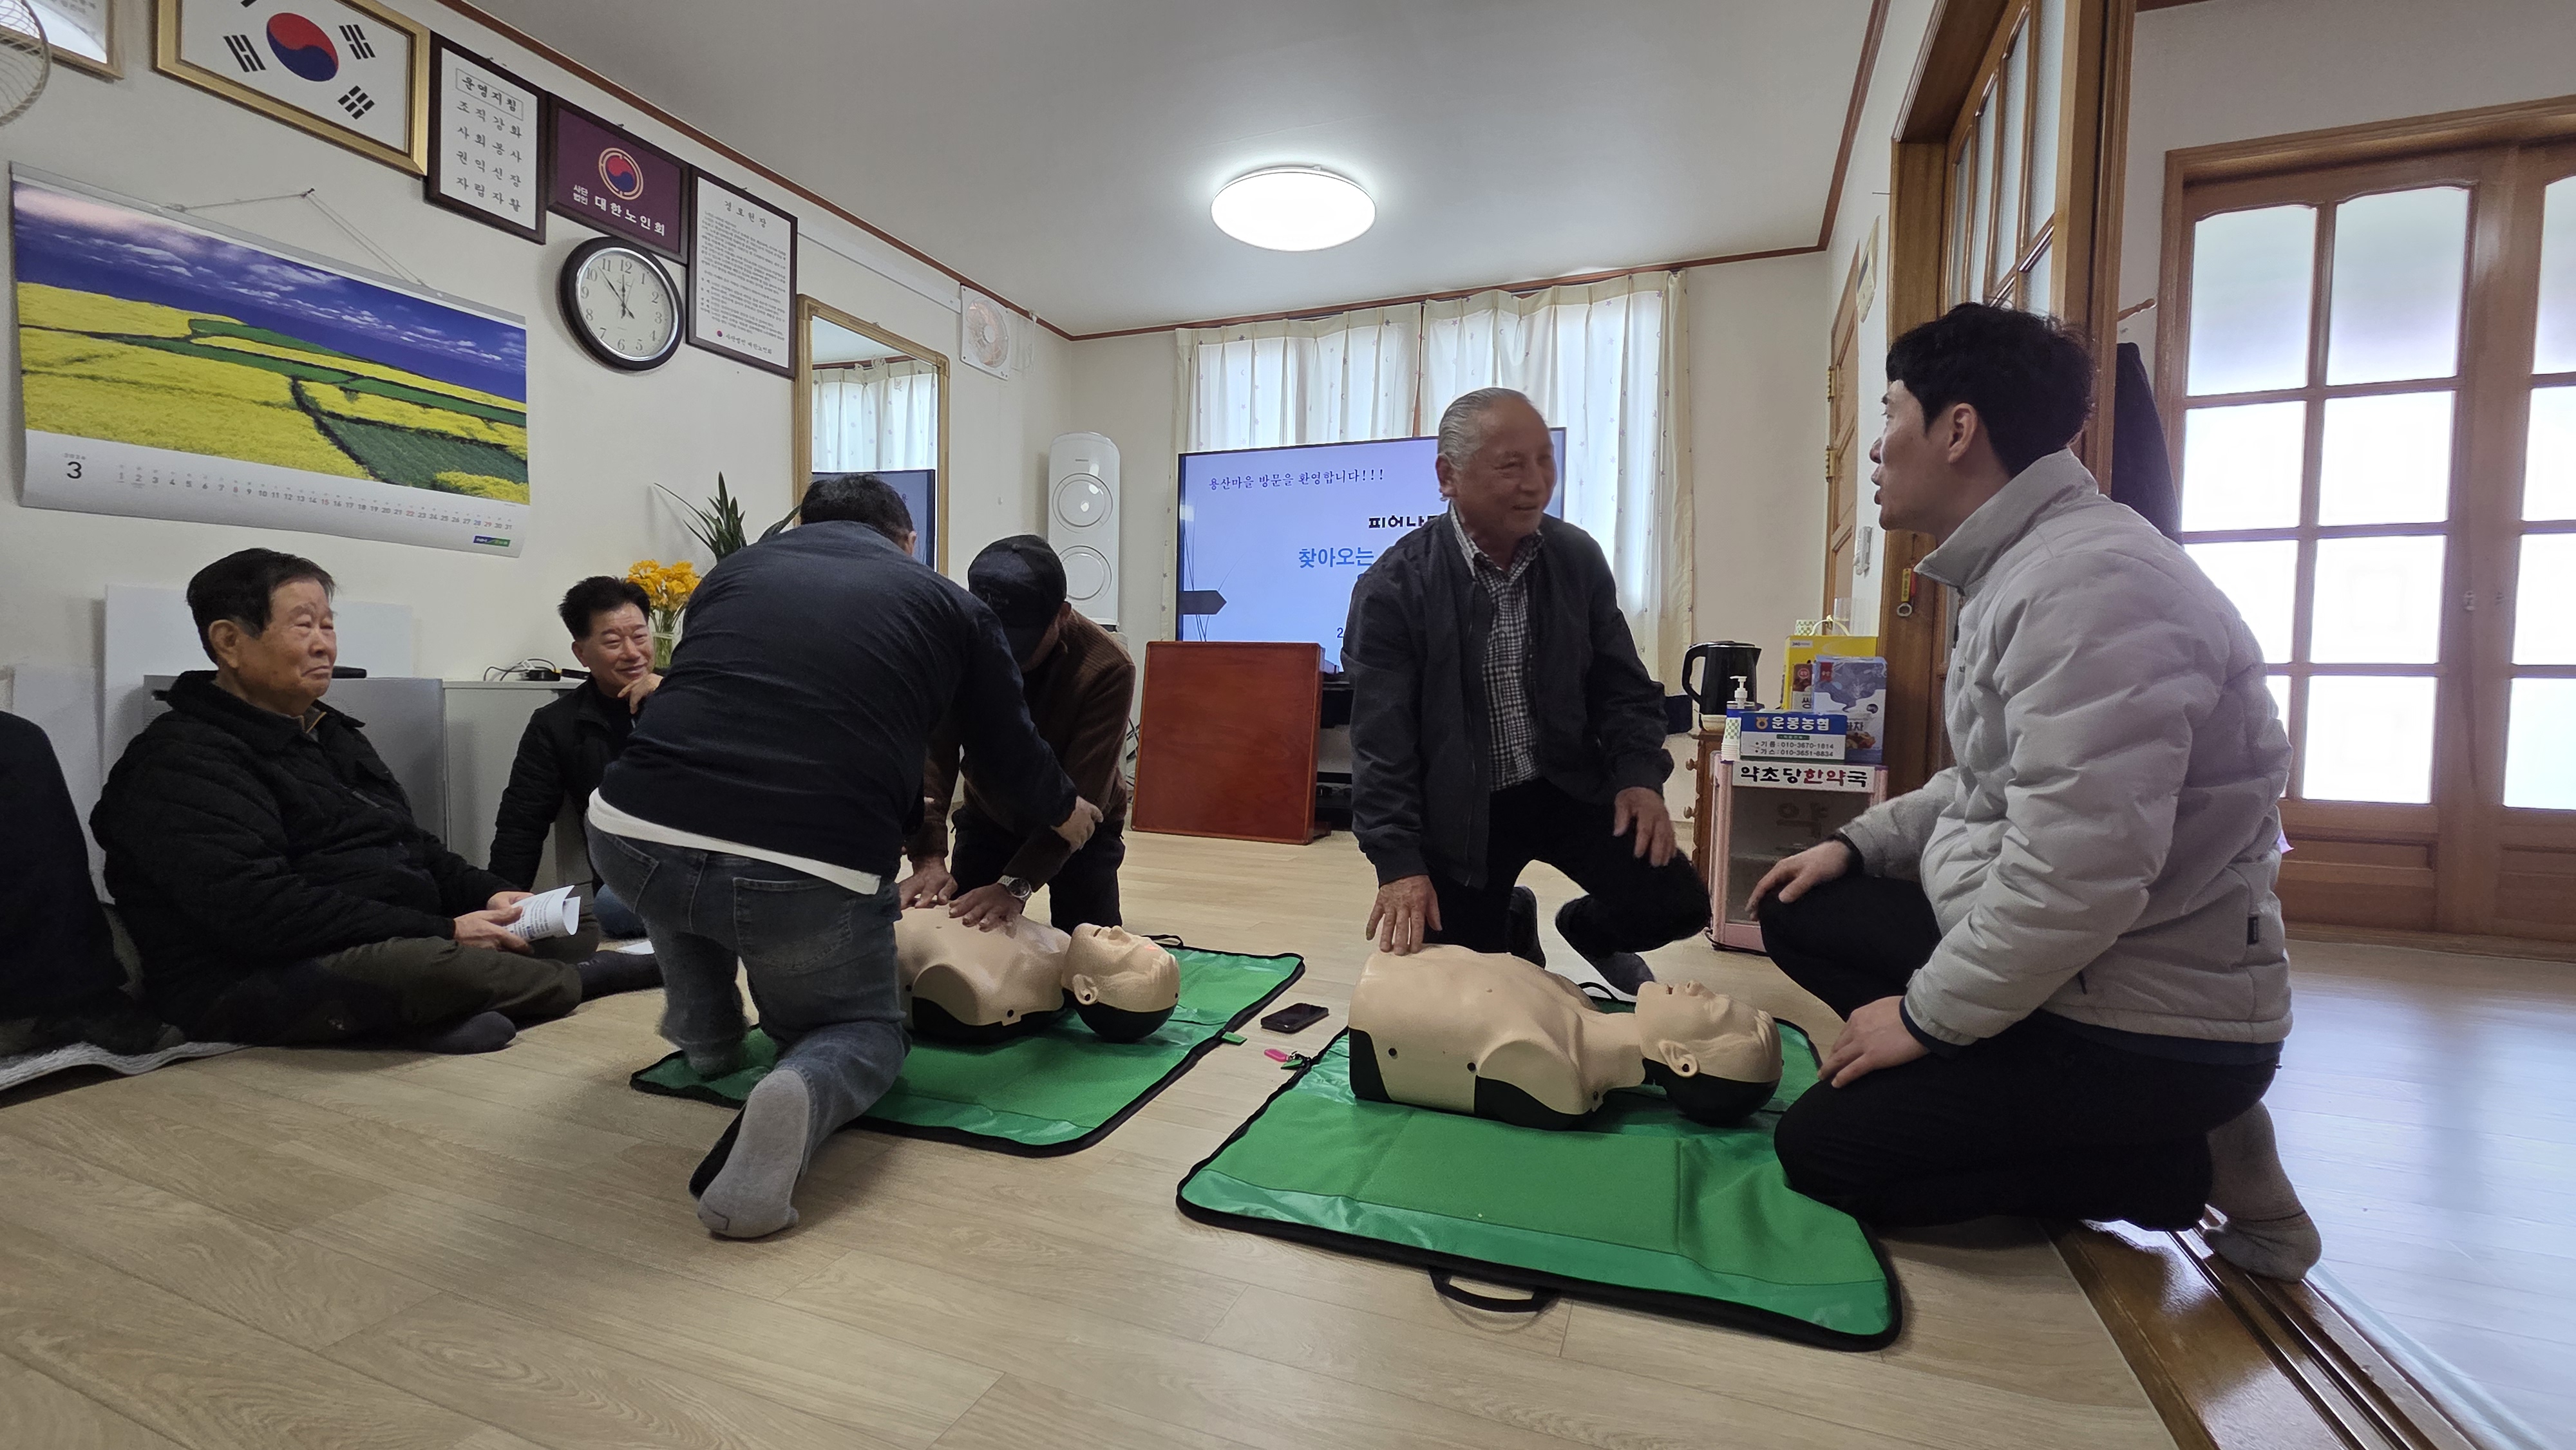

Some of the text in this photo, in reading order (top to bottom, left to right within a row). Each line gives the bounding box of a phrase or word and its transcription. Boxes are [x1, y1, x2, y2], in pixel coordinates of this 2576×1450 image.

[462, 77, 517, 112] 운영지침
[457, 100, 522, 138] 조직강화
[457, 126, 522, 163] 사회봉사
[456, 151, 522, 187] 권익신장
[456, 177, 521, 212] 자립자활
[573, 184, 589, 196] 사단
[573, 193, 588, 205] 법인
[594, 195, 665, 236] 대한노인회
[601, 258, 611, 272] 11
[620, 259, 632, 274] 12
[586, 267, 598, 281] 10
[641, 273, 645, 285] 1
[580, 286, 589, 299] 9
[652, 291, 659, 304] 2
[585, 308, 594, 321] 8
[654, 312, 662, 324] 3
[600, 327, 607, 339] 7
[649, 330, 656, 341] 4
[617, 338, 625, 351] 6
[636, 339, 643, 351] 5
[67, 461, 82, 479] 3
[1209, 469, 1383, 491] 용산마을 방문을 환영합니다!!!
[1368, 515, 1437, 529] 피어나
[1298, 547, 1374, 568] 찾아오는
[1337, 627, 1344, 638] 2
[1772, 716, 1830, 731] 운봉농협
[1741, 766, 1868, 787] 약초당한약국
